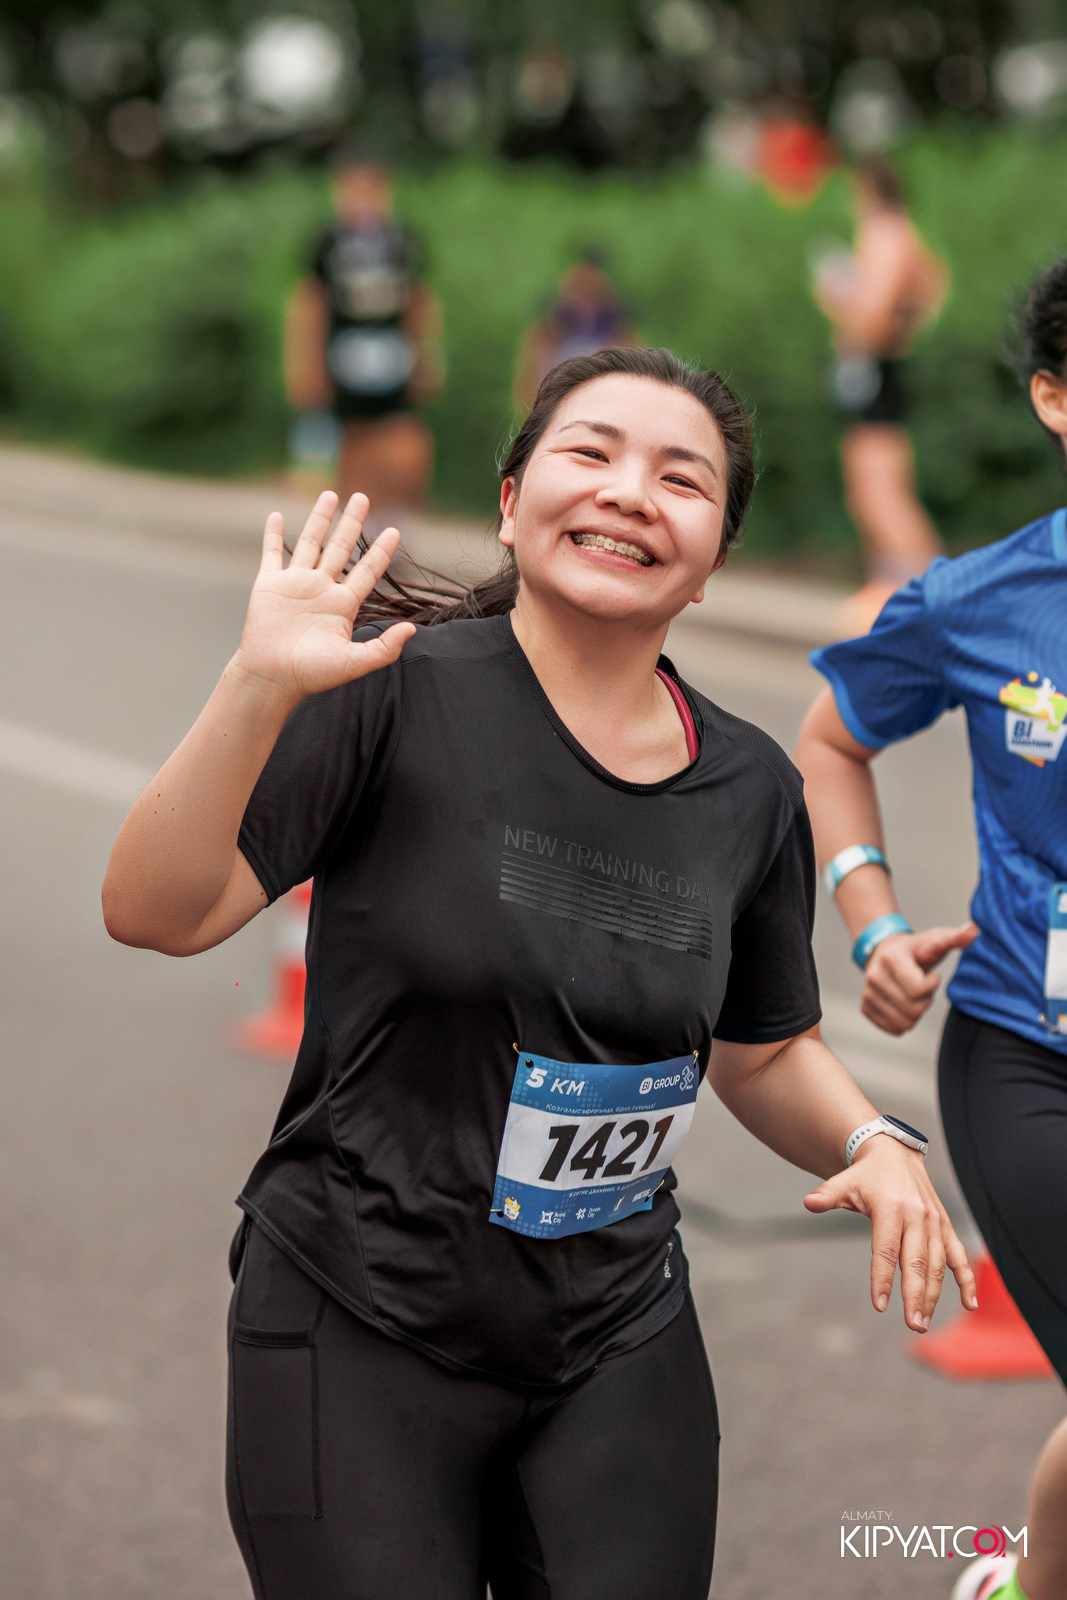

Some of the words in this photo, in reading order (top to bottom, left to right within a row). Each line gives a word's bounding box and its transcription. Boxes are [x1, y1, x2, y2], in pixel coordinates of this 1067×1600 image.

[1014, 720, 1033, 737] BI
[503, 825, 559, 858] NEW
[563, 841, 671, 893] TRAINING
[676, 876, 711, 907] DAY
[525, 1066, 549, 1088] 5
[550, 1078, 585, 1097] KM
[653, 1074, 681, 1090] GROUP
[539, 1114, 675, 1182] 1421
